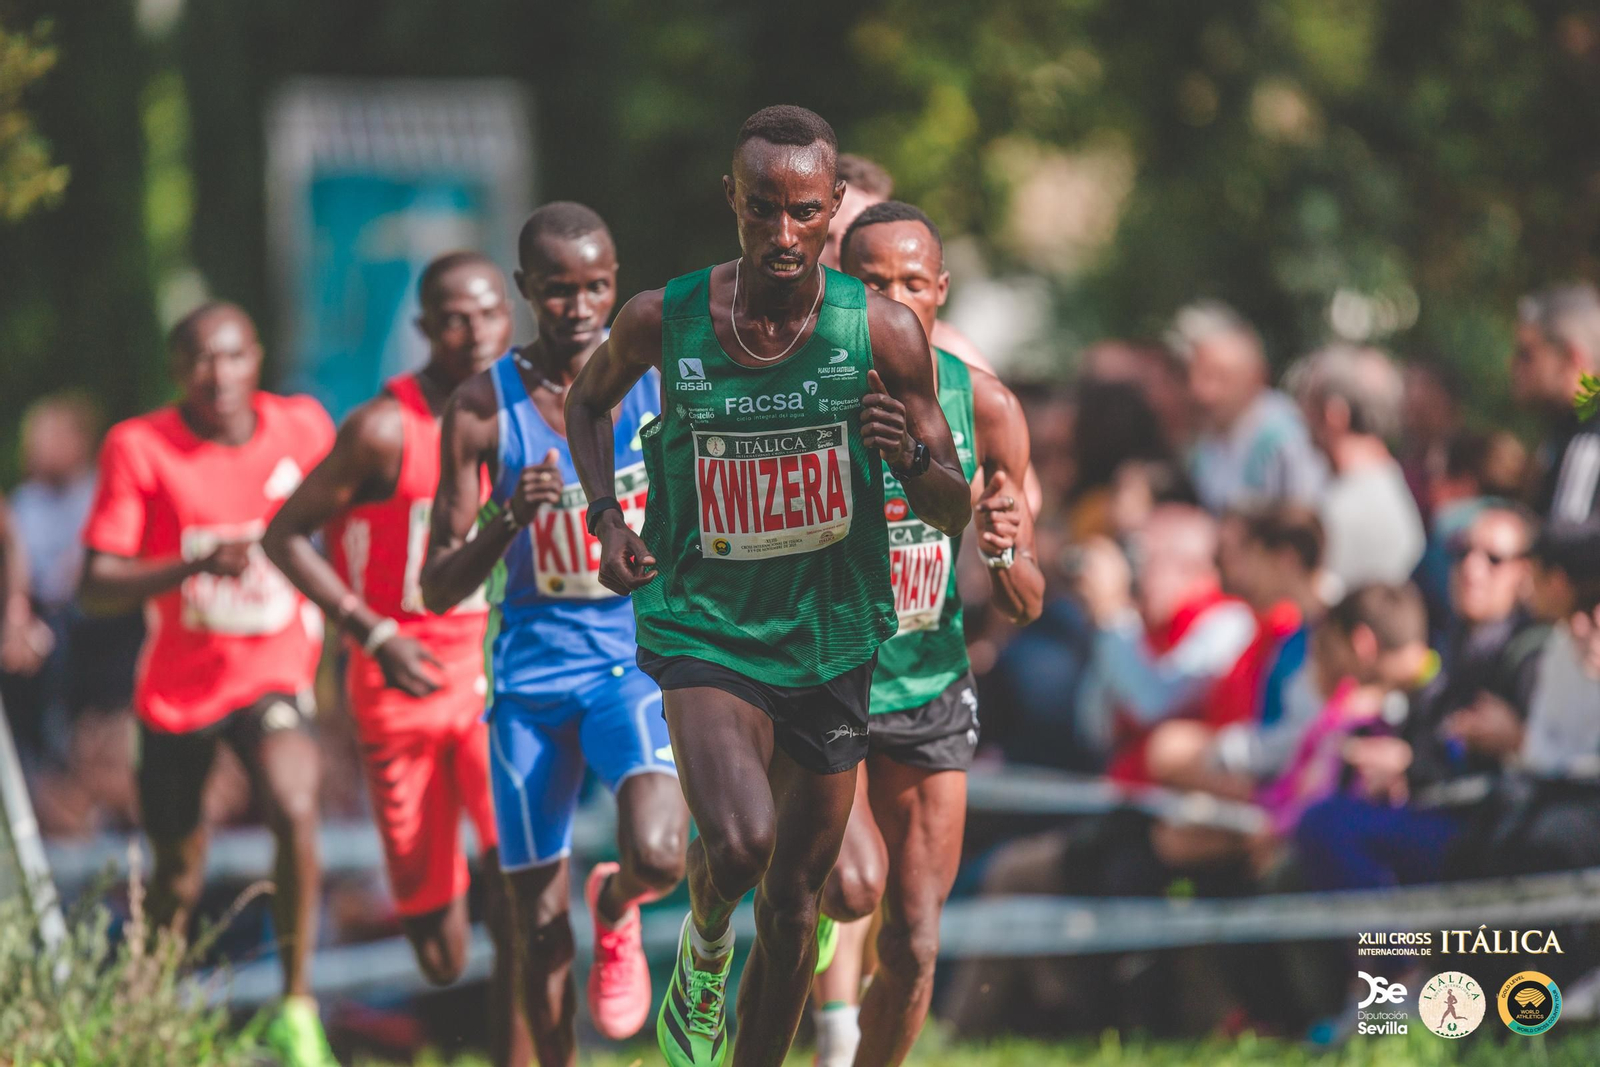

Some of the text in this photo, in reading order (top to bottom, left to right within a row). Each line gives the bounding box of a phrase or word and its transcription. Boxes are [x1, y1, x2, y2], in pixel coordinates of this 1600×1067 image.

[676, 380, 712, 391] rasán
[725, 392, 804, 415] Facsa
[689, 411, 715, 419] Castelló
[735, 437, 807, 454] ITÁLICA
[698, 448, 848, 534] KWIZERA
